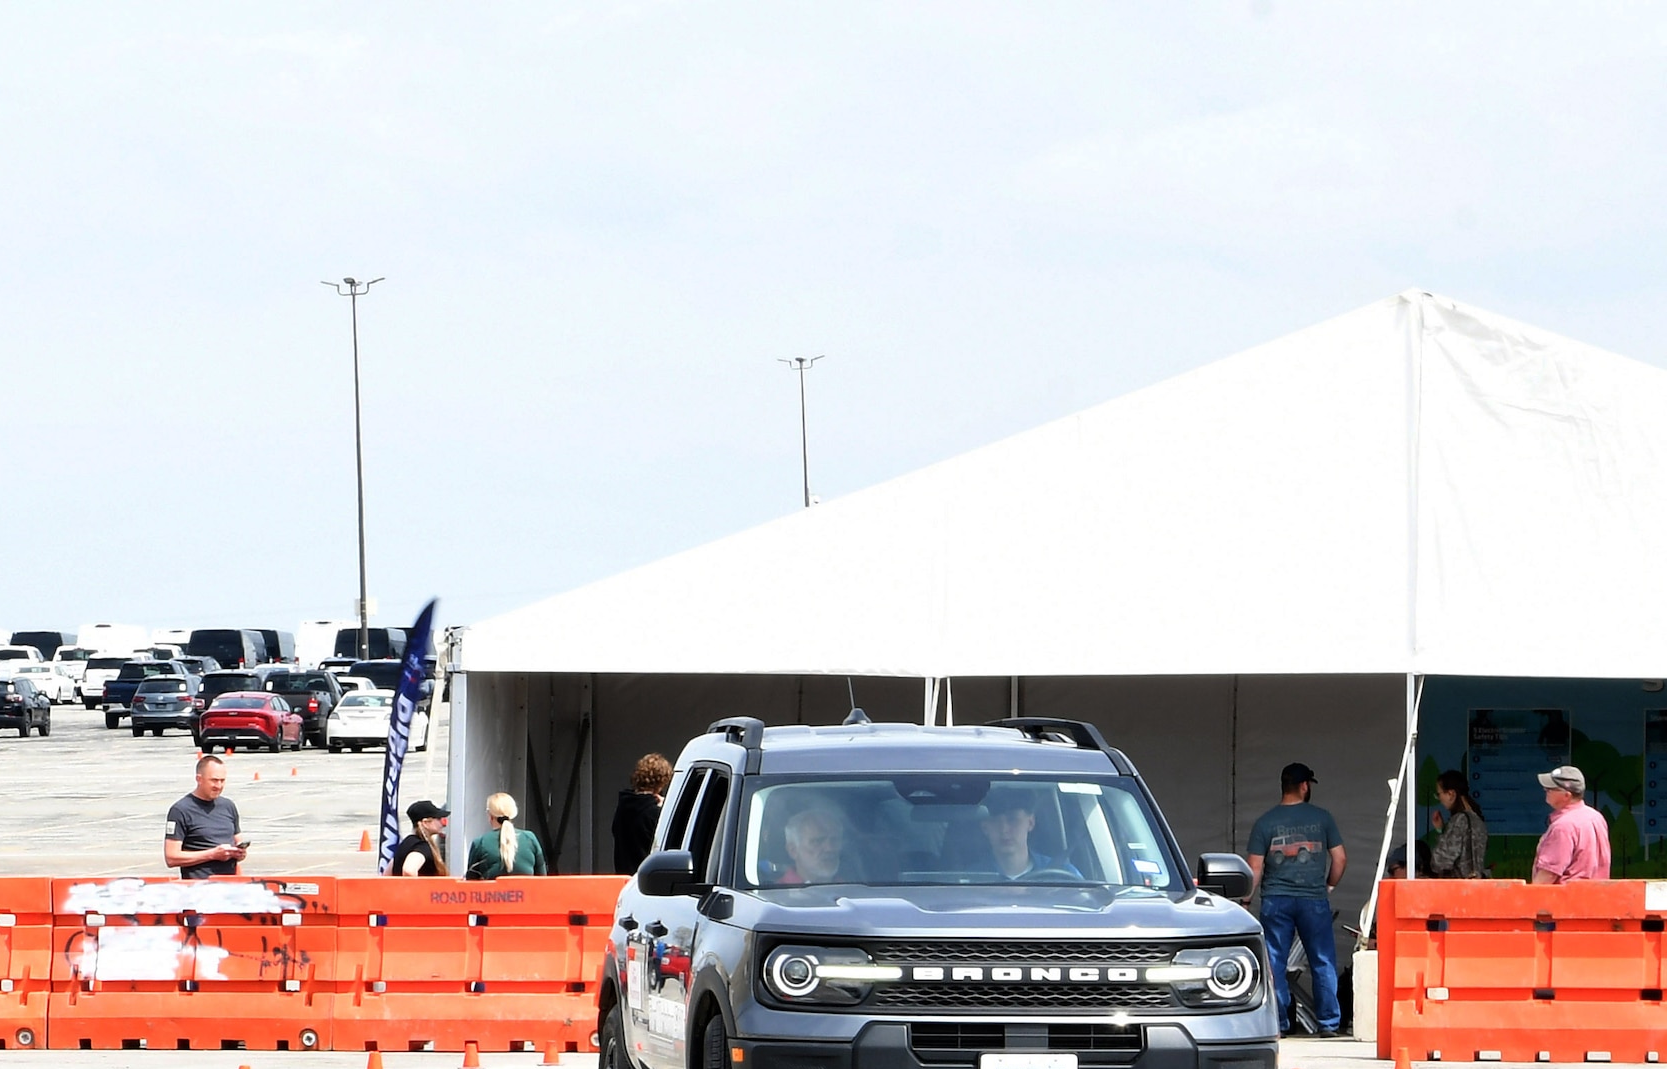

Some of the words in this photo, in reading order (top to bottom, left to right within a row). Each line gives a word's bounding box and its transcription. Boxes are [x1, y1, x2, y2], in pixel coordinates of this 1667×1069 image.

[430, 891, 467, 904] ROAD
[470, 890, 524, 903] RUNNER
[912, 967, 1138, 981] BRONCO
